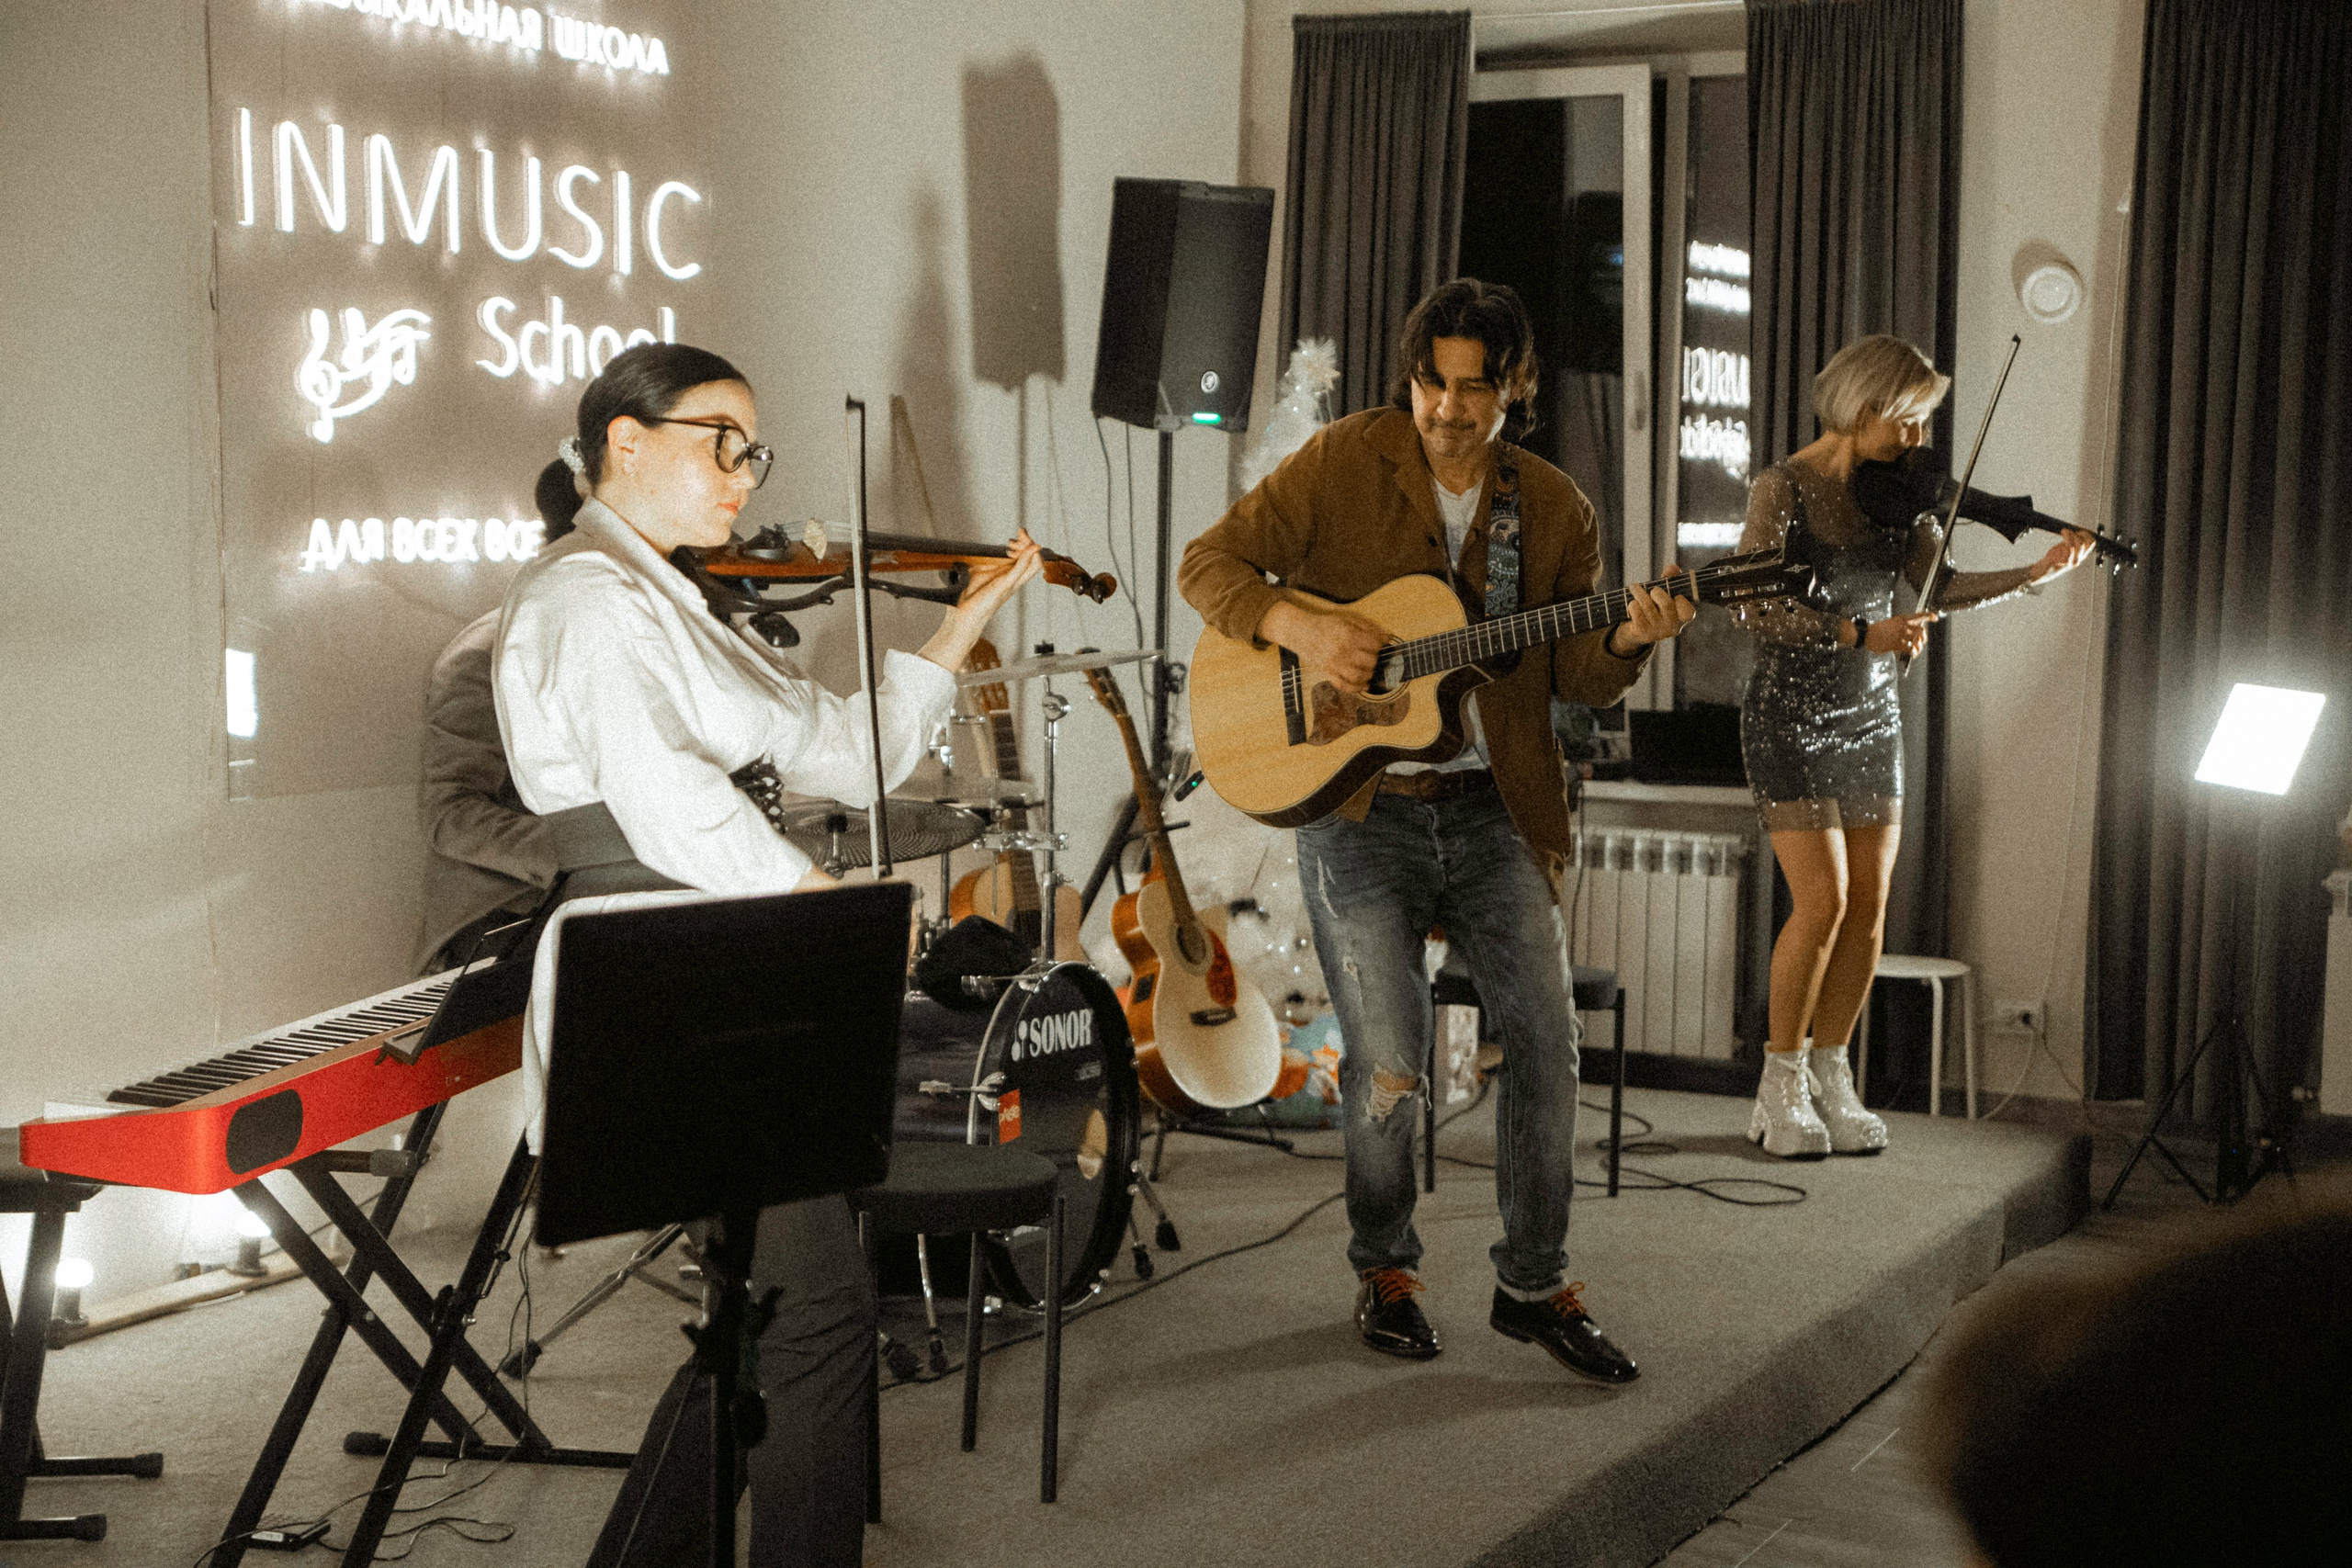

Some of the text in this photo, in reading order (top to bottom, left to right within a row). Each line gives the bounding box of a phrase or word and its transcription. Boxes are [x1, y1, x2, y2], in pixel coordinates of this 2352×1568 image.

[292, 0, 670, 74] КАЛЬНАЯ ШКОЛА
[235, 107, 703, 280] INMUSIC
[299, 517, 385, 571] ДЛЯ
[392, 517, 480, 563] ВСЕХ
[1029, 1009, 1092, 1057] SONOR
